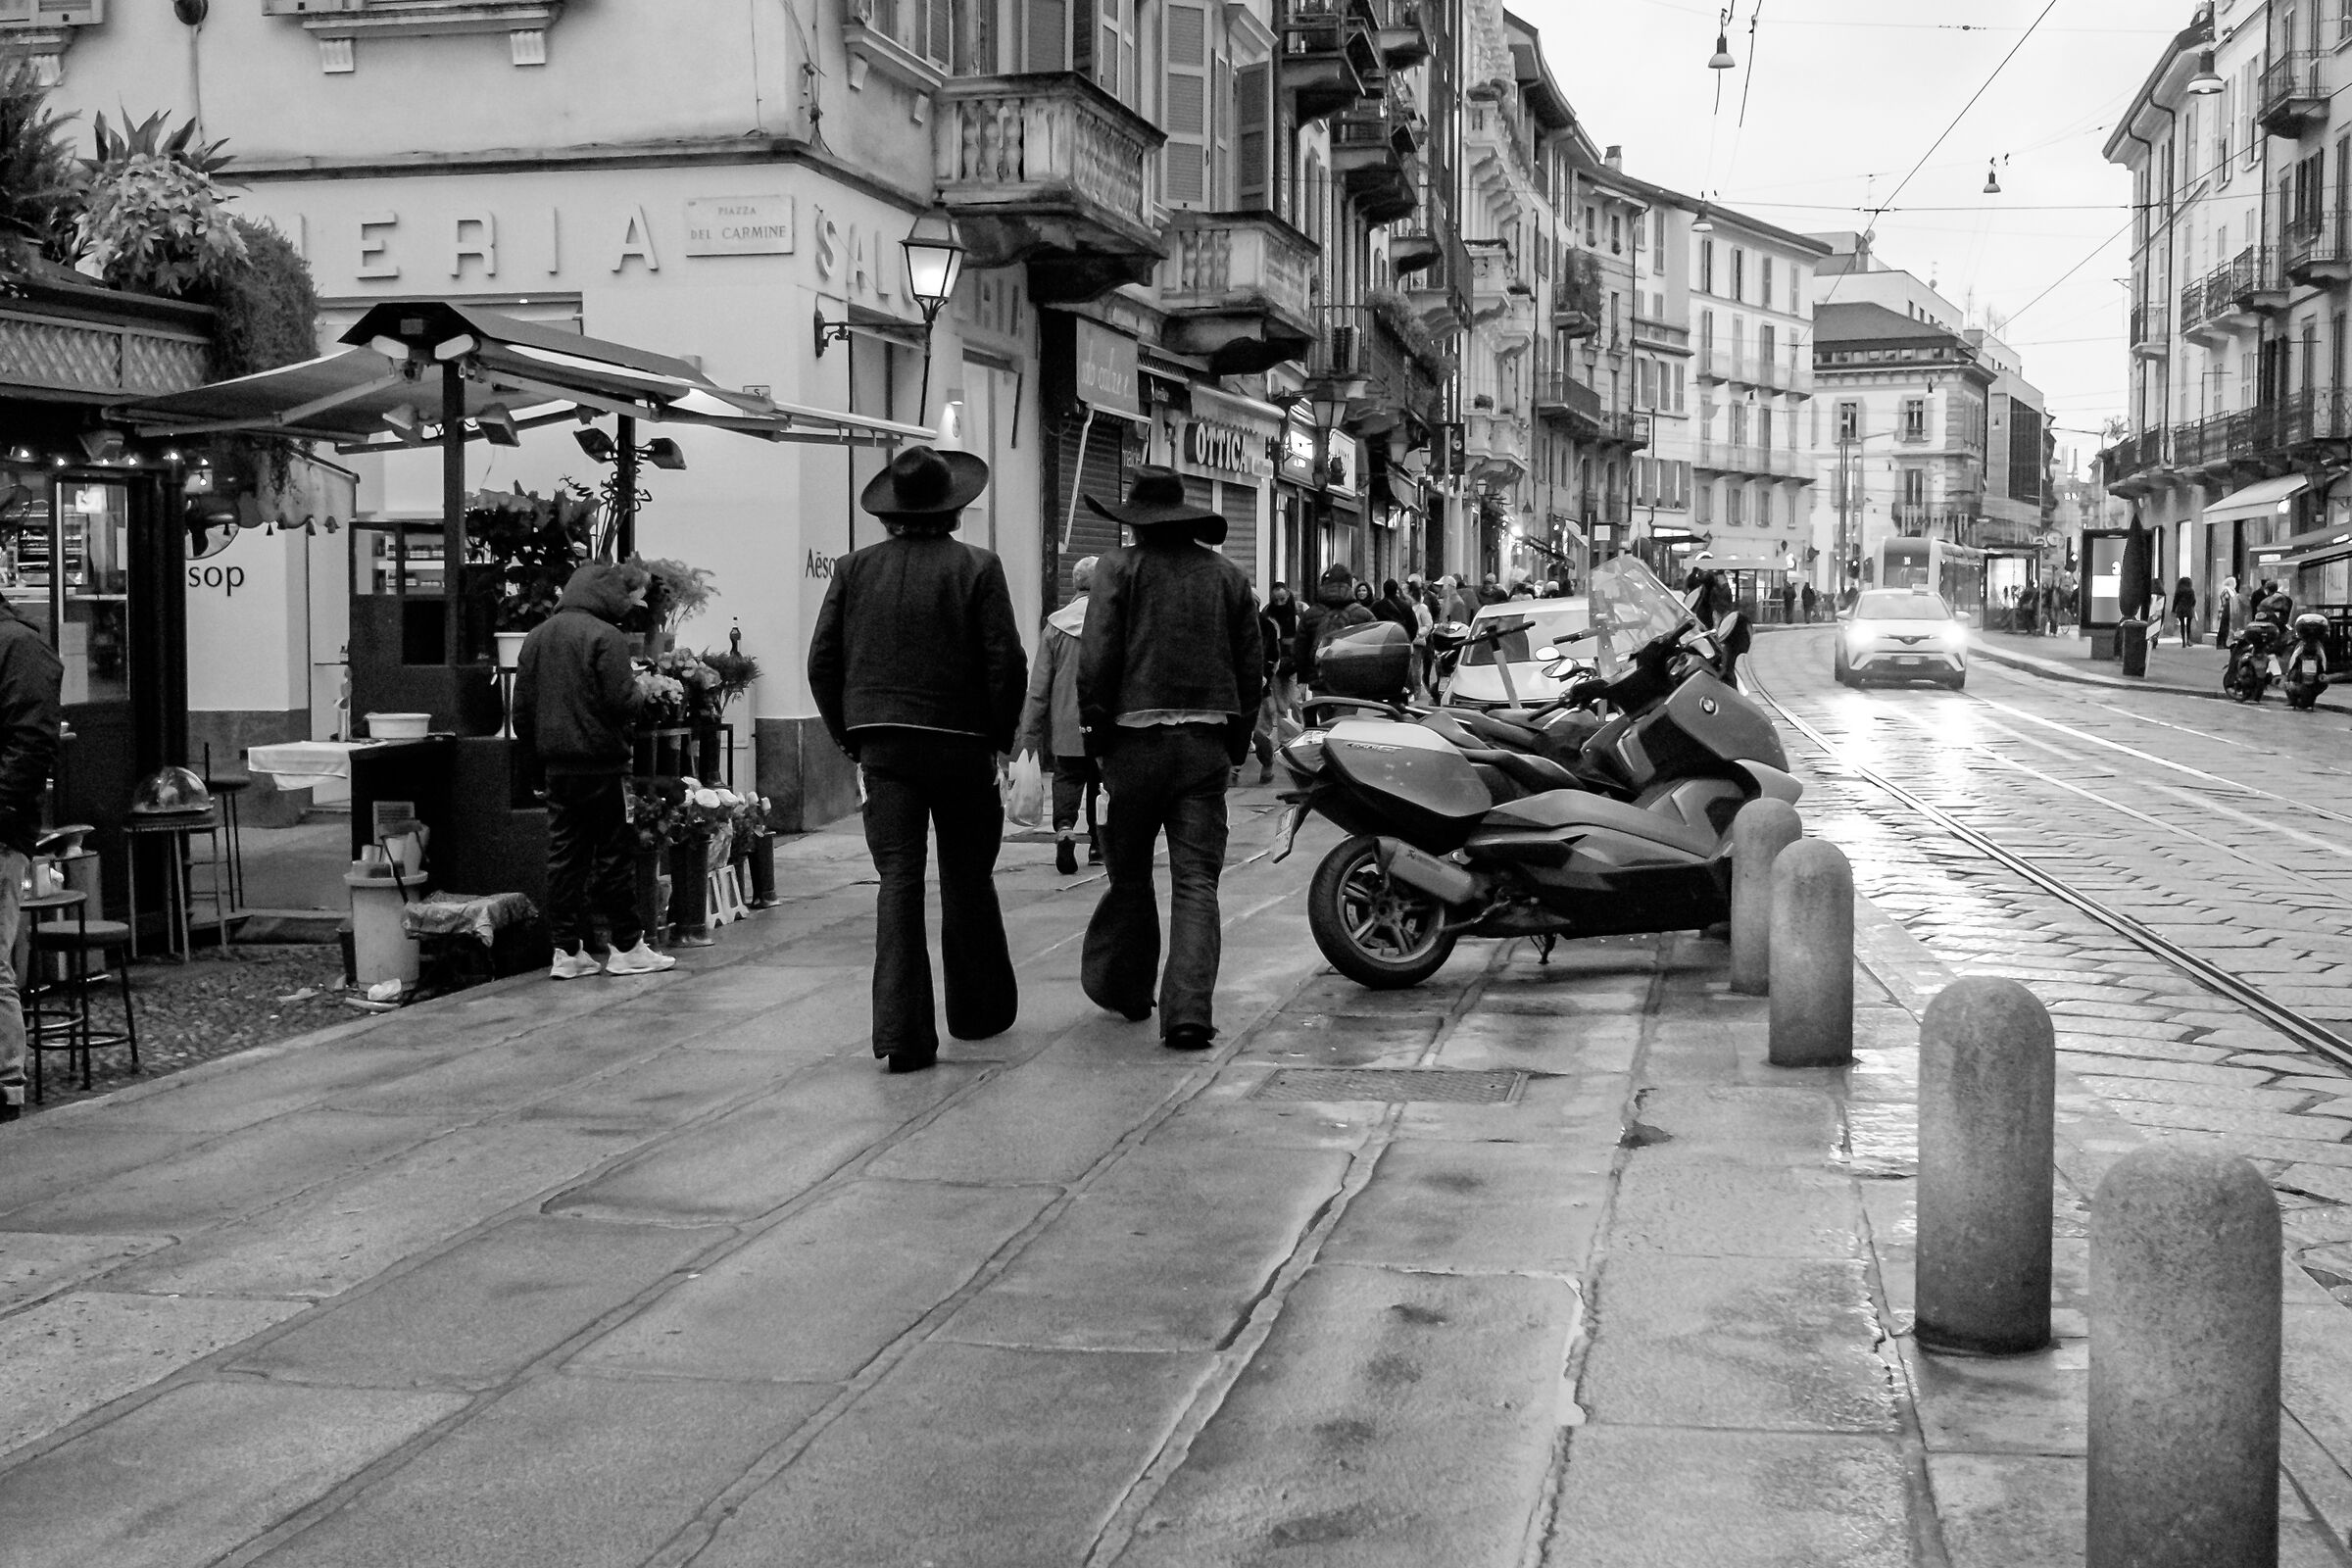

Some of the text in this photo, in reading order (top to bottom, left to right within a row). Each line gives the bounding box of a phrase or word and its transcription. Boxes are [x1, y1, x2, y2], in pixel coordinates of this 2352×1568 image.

[717, 206, 757, 216] PIAZZA
[294, 203, 660, 281] ERIA
[690, 225, 786, 240] DEL CARMINE
[1196, 421, 1250, 473] OTTICA
[188, 565, 245, 597] sop
